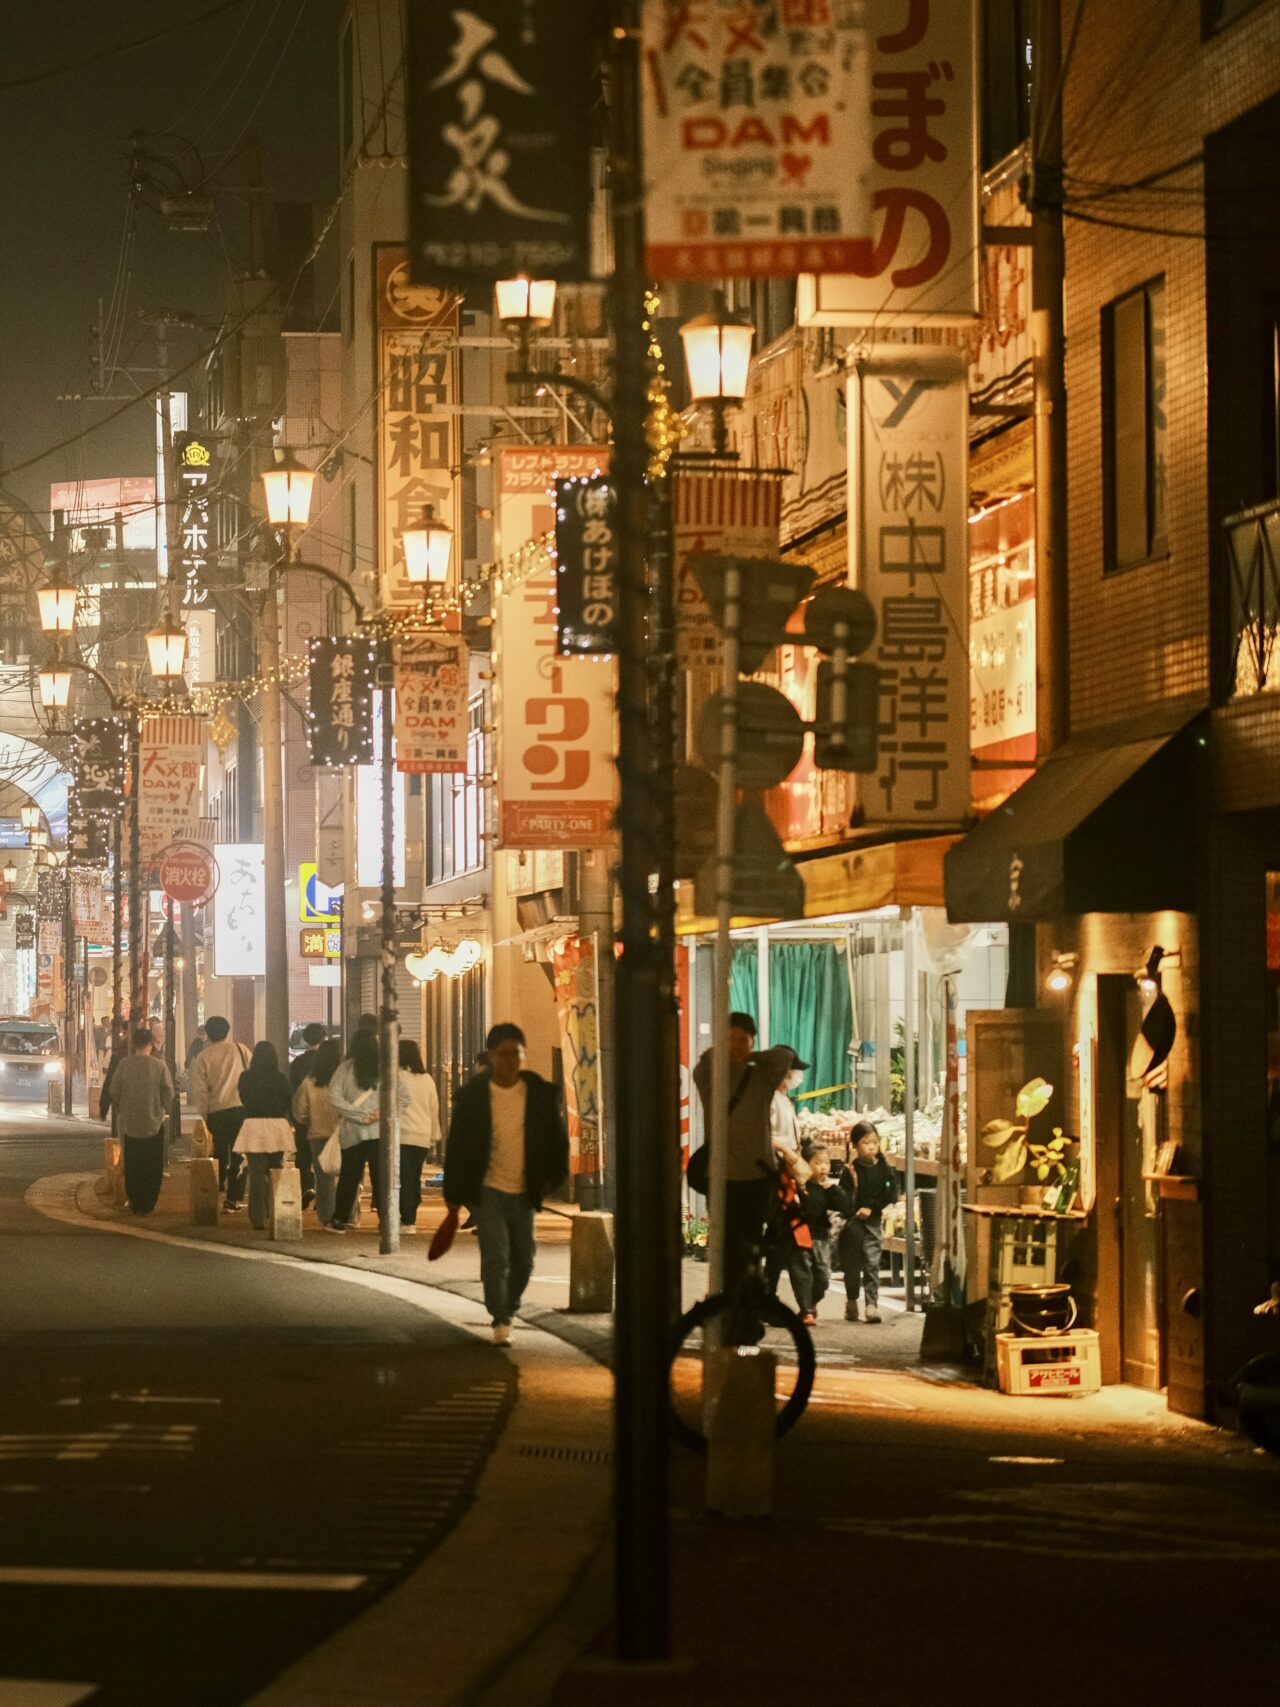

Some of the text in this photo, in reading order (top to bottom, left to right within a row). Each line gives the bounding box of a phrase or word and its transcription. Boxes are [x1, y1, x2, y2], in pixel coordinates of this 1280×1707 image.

[682, 113, 830, 151] DAM
[511, 456, 598, 470] レストラン &
[182, 473, 209, 605] アパホテル
[331, 653, 355, 750] 銀座通り
[404, 696, 457, 713] 全員集合
[405, 716, 456, 728] DAM
[142, 747, 197, 778] 天文館
[142, 780, 181, 788] DAM
[165, 867, 207, 887] 消火栓
[305, 934, 324, 952] 満
[1031, 1369, 1079, 1379] アサヒビール
